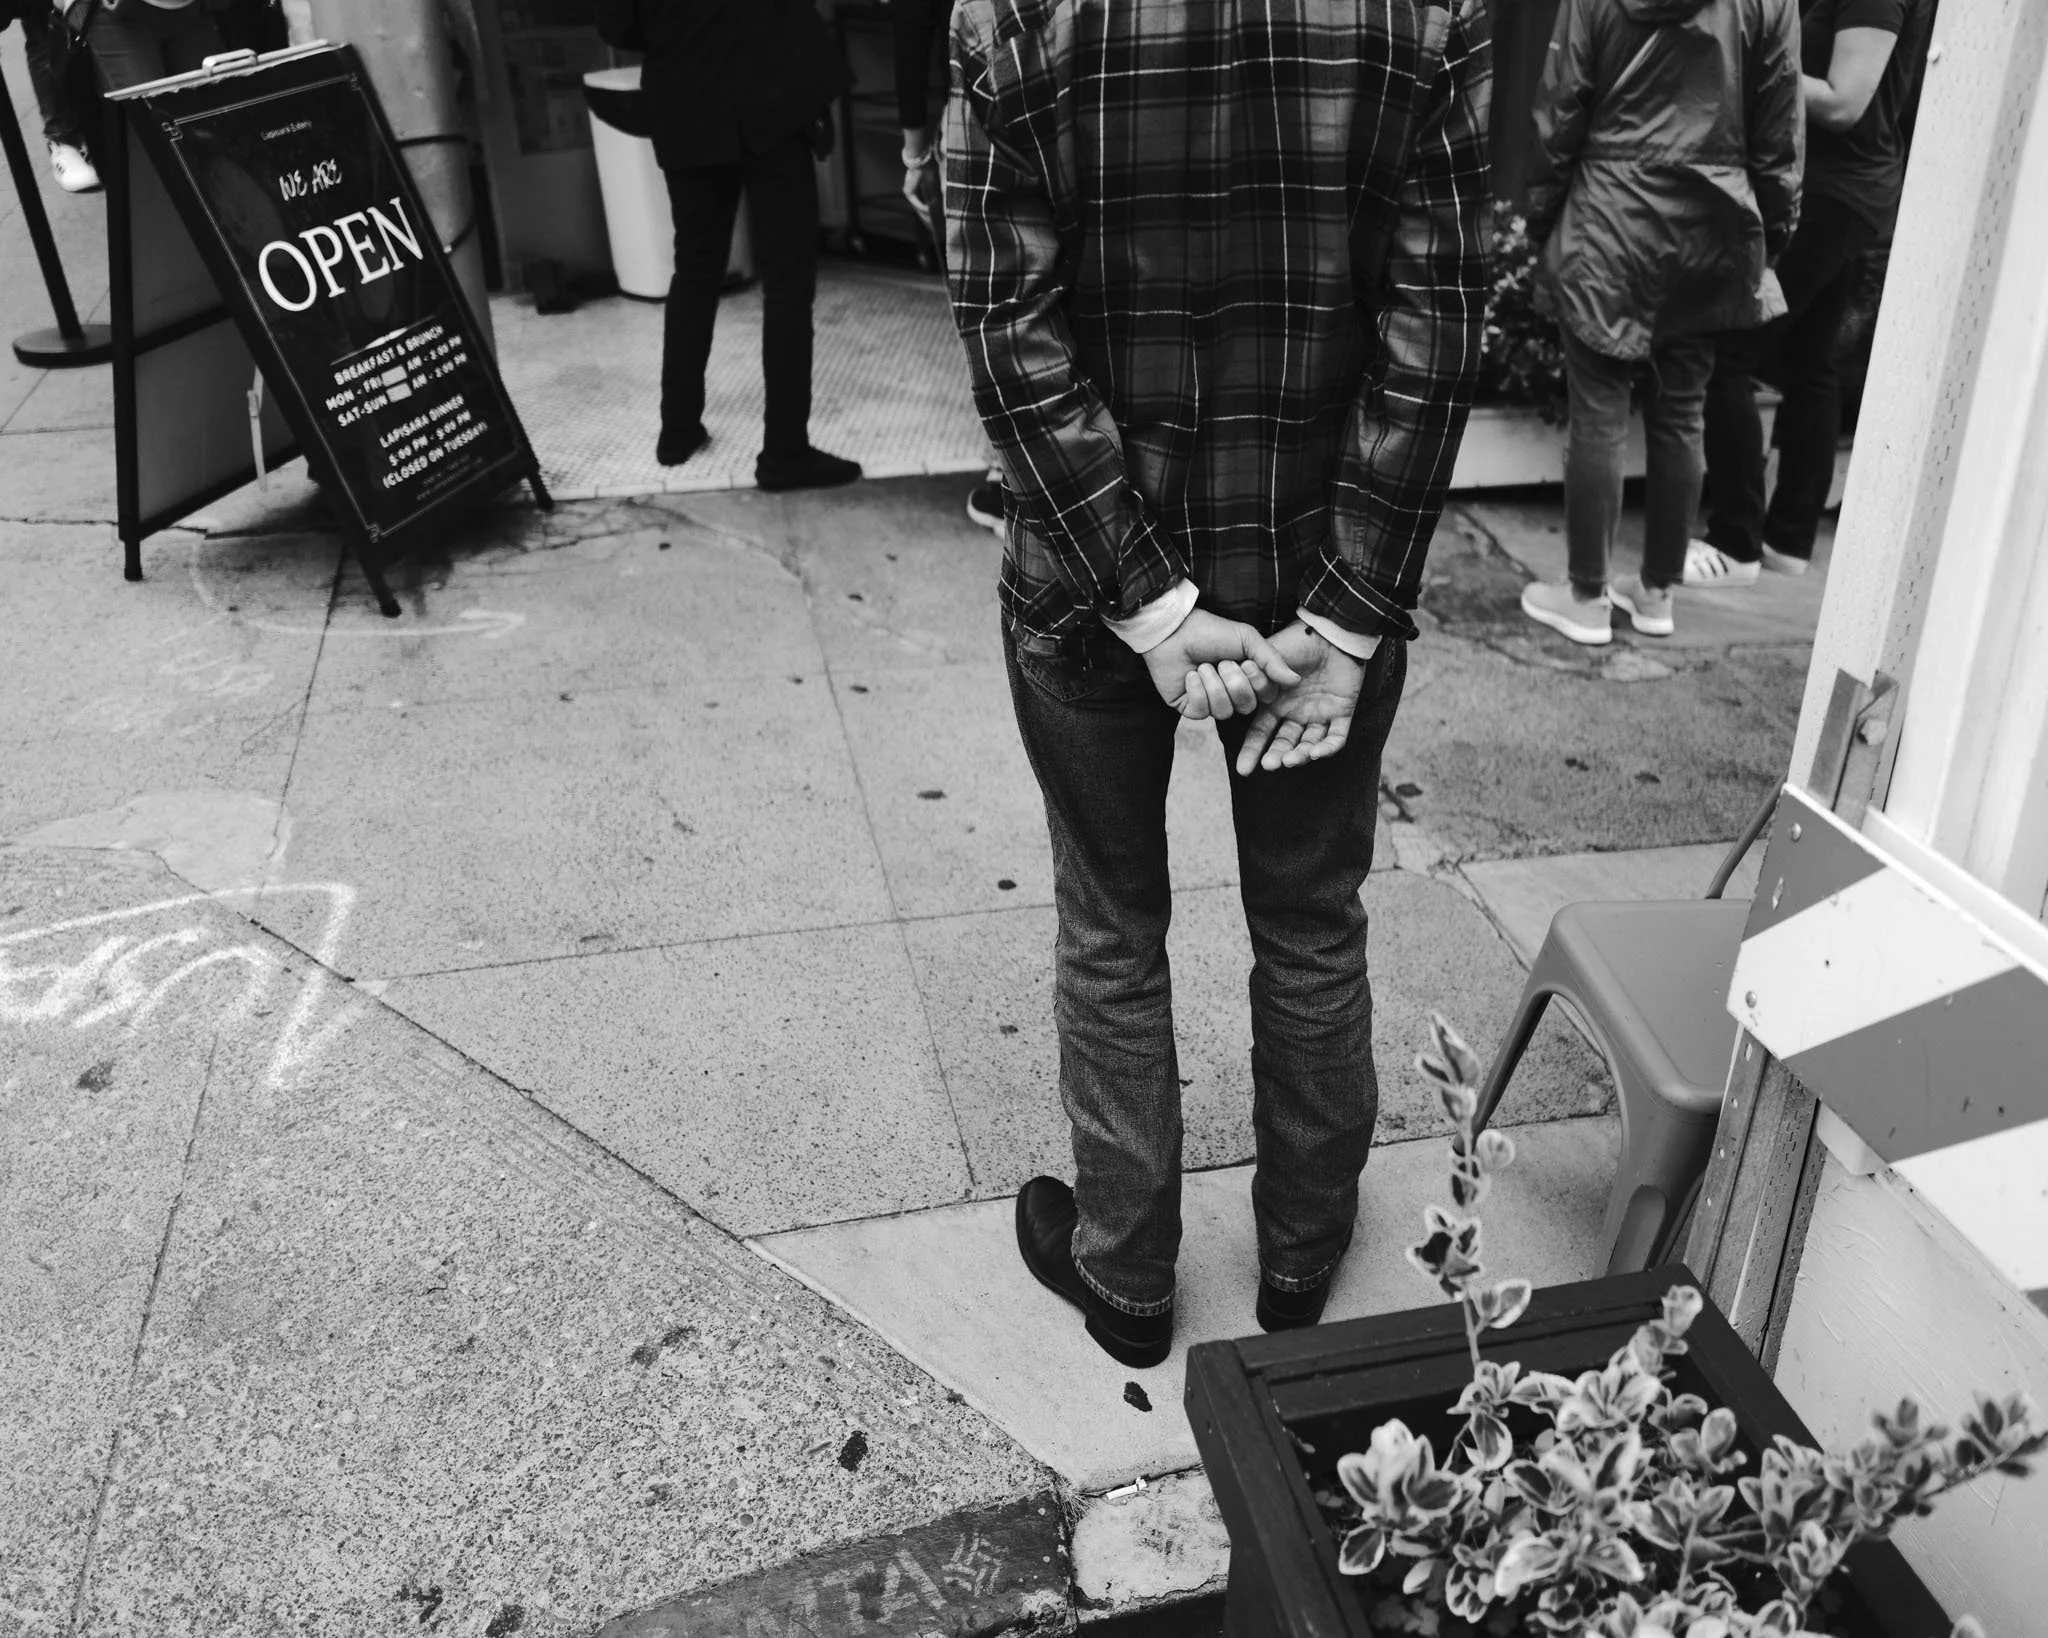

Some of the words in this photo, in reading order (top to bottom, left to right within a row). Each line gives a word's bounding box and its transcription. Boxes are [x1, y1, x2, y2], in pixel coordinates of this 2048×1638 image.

[279, 169, 308, 201] WE
[312, 158, 342, 194] ARE
[258, 197, 424, 312] OPEN
[325, 388, 355, 411] MON
[363, 375, 383, 393] FRI
[407, 355, 422, 372] AM
[448, 335, 462, 349] PM
[334, 347, 395, 386] BREAKFAST
[405, 325, 444, 351] BRUNCH
[337, 394, 388, 427] SAT-SUN
[412, 373, 428, 390] AM
[453, 352, 467, 366] PM
[379, 413, 430, 448] LAPISARA
[428, 393, 464, 421] DINNER
[388, 445, 412, 467] 5:00
[412, 435, 428, 452] PM
[456, 409, 471, 426] PM
[382, 455, 428, 488] (CLOSED
[428, 446, 444, 463] ON
